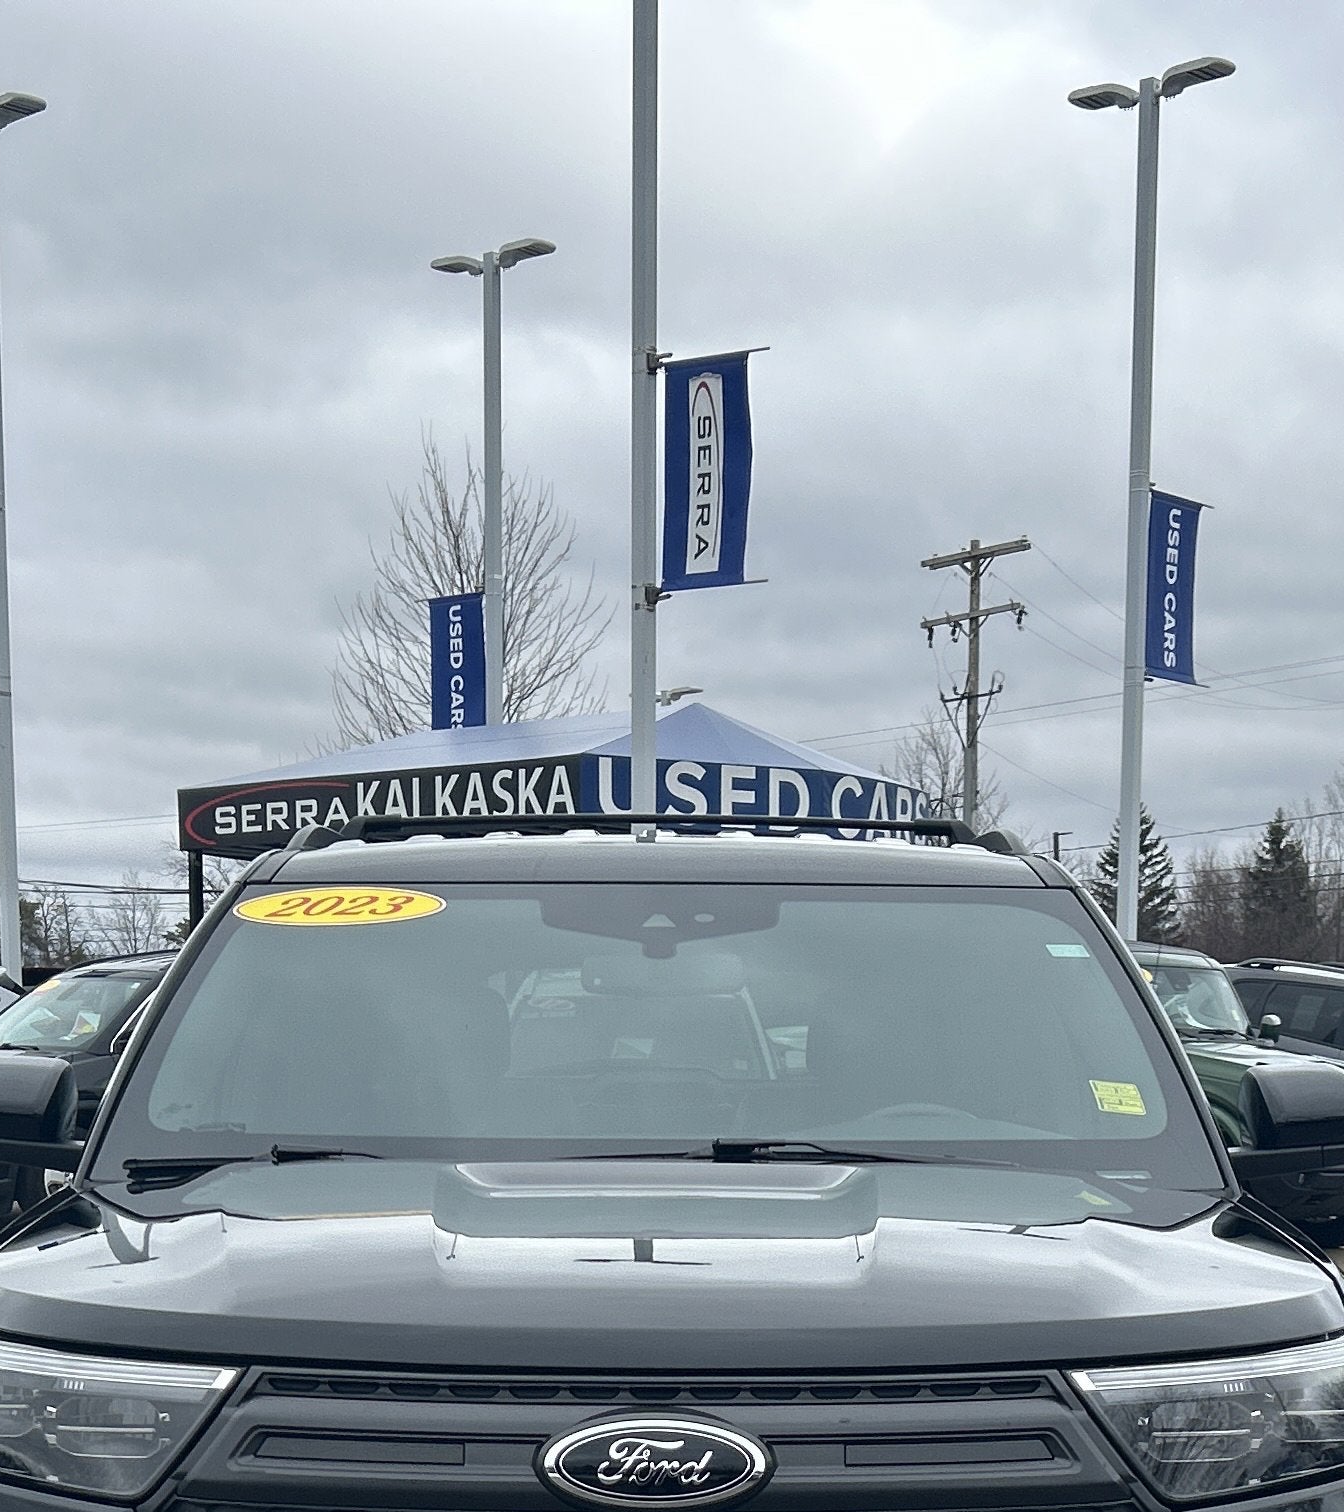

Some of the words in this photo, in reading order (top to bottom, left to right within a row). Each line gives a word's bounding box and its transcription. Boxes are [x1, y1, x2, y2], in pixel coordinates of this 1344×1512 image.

[693, 415, 712, 560] SERRA
[1166, 508, 1182, 585] USED
[448, 604, 463, 669] USED
[1163, 592, 1177, 668] CARS
[214, 796, 350, 835] SERRA
[264, 895, 415, 918] 2023
[597, 1437, 714, 1486] Ford
